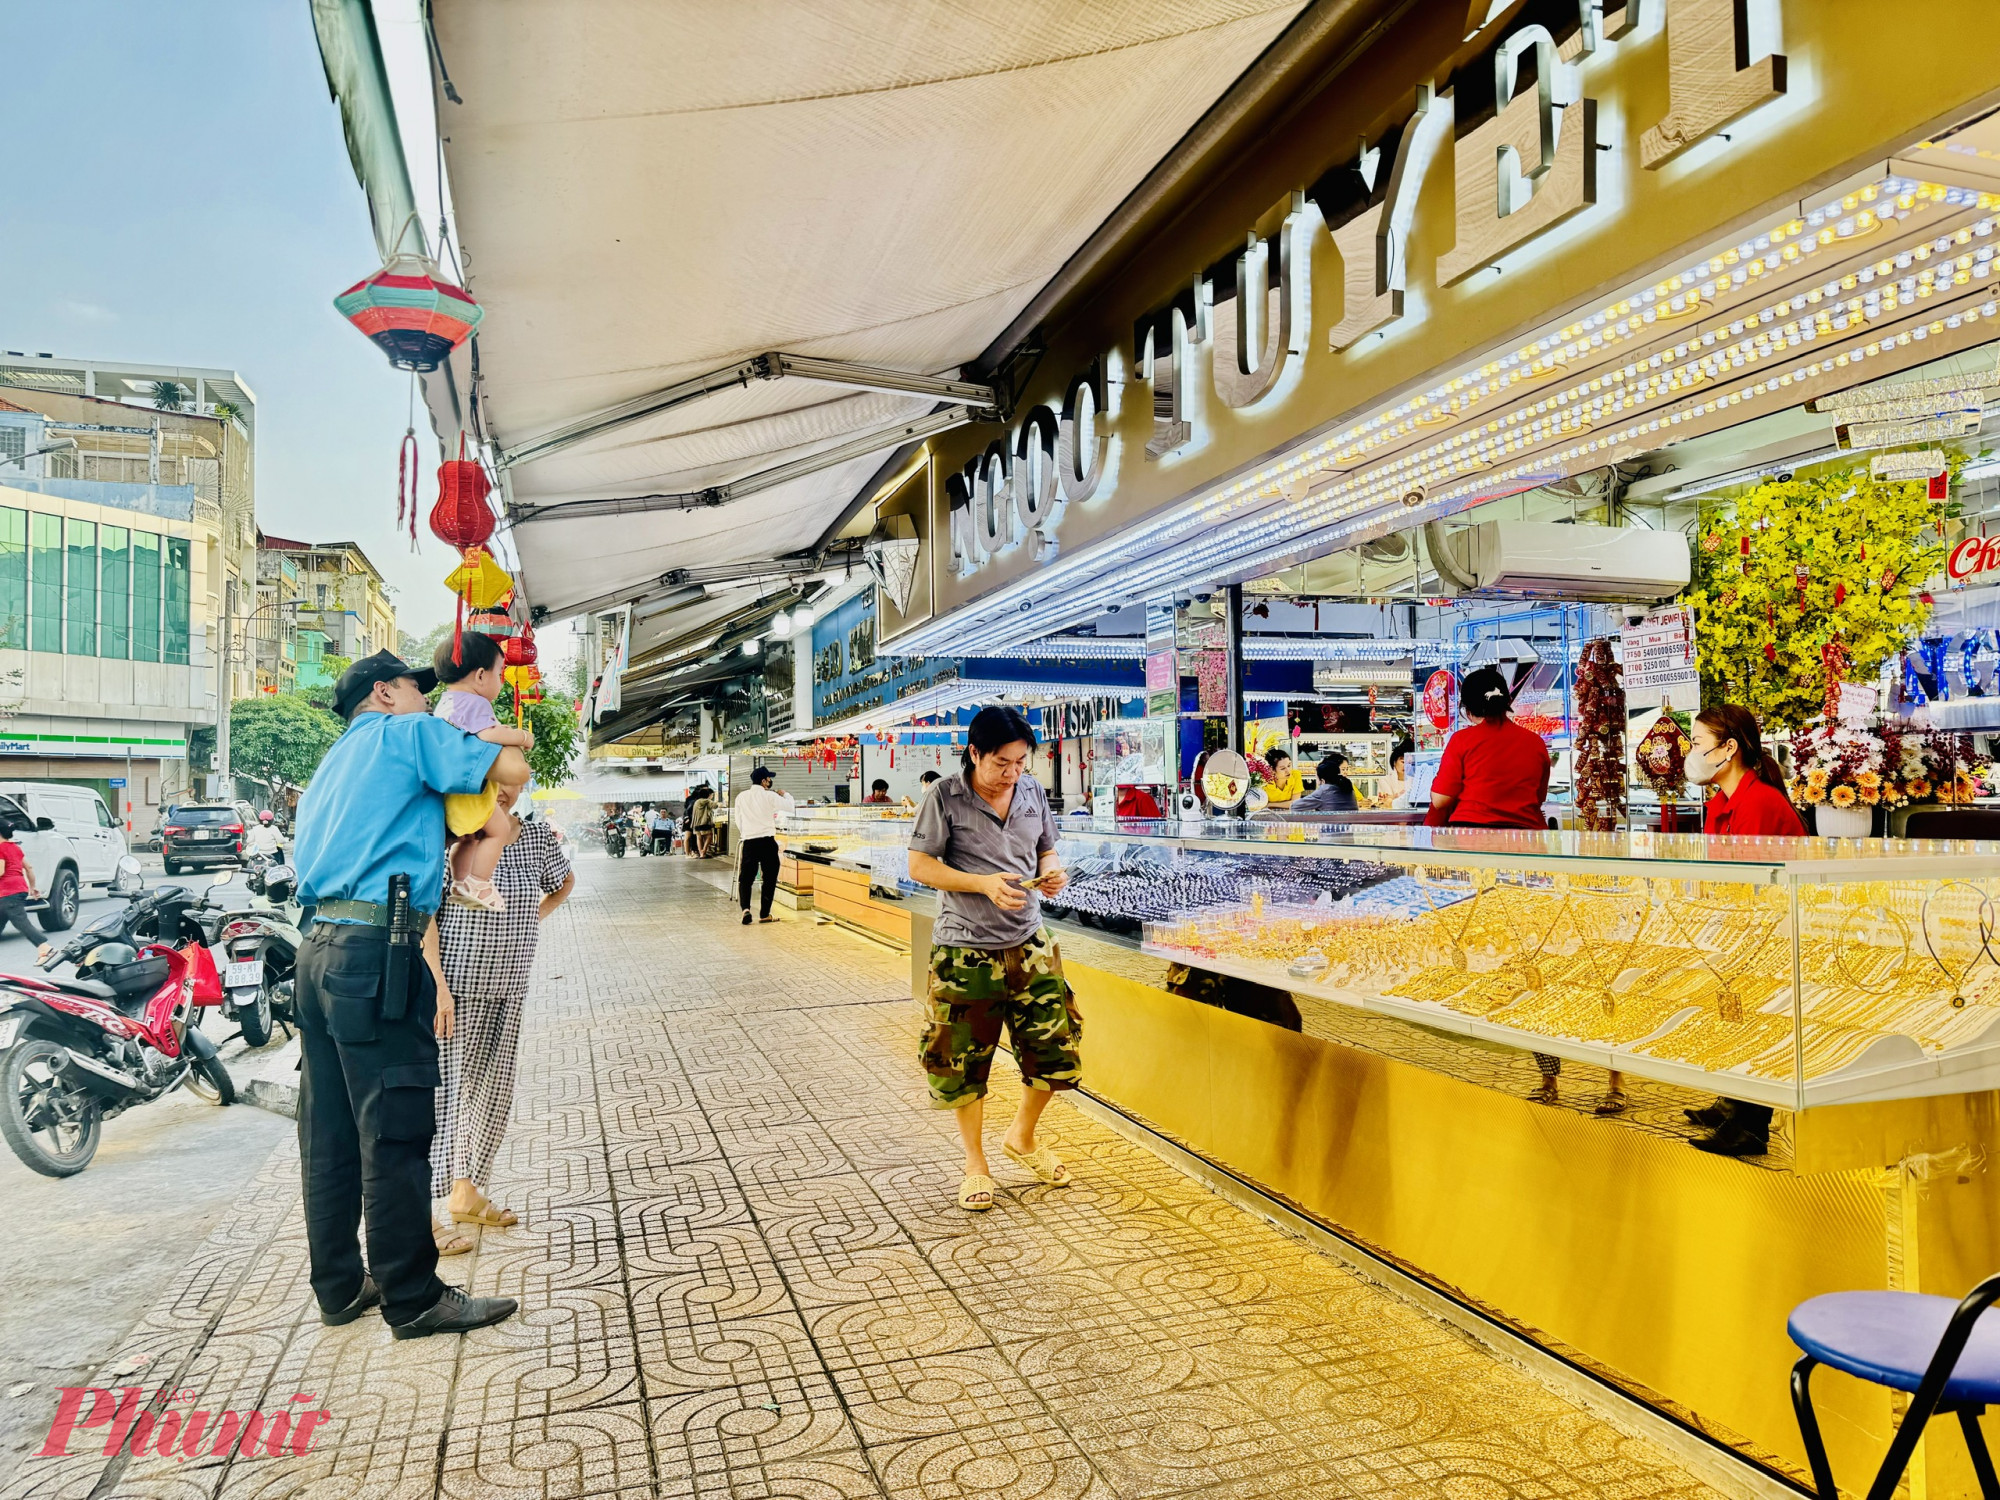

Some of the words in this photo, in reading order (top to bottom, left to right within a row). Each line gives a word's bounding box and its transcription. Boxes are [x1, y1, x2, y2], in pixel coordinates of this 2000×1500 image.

[945, 352, 1110, 575] NGỌC
[1948, 534, 2000, 579] Ch
[1041, 704, 1067, 741] KIM
[1070, 697, 1098, 737] SEN
